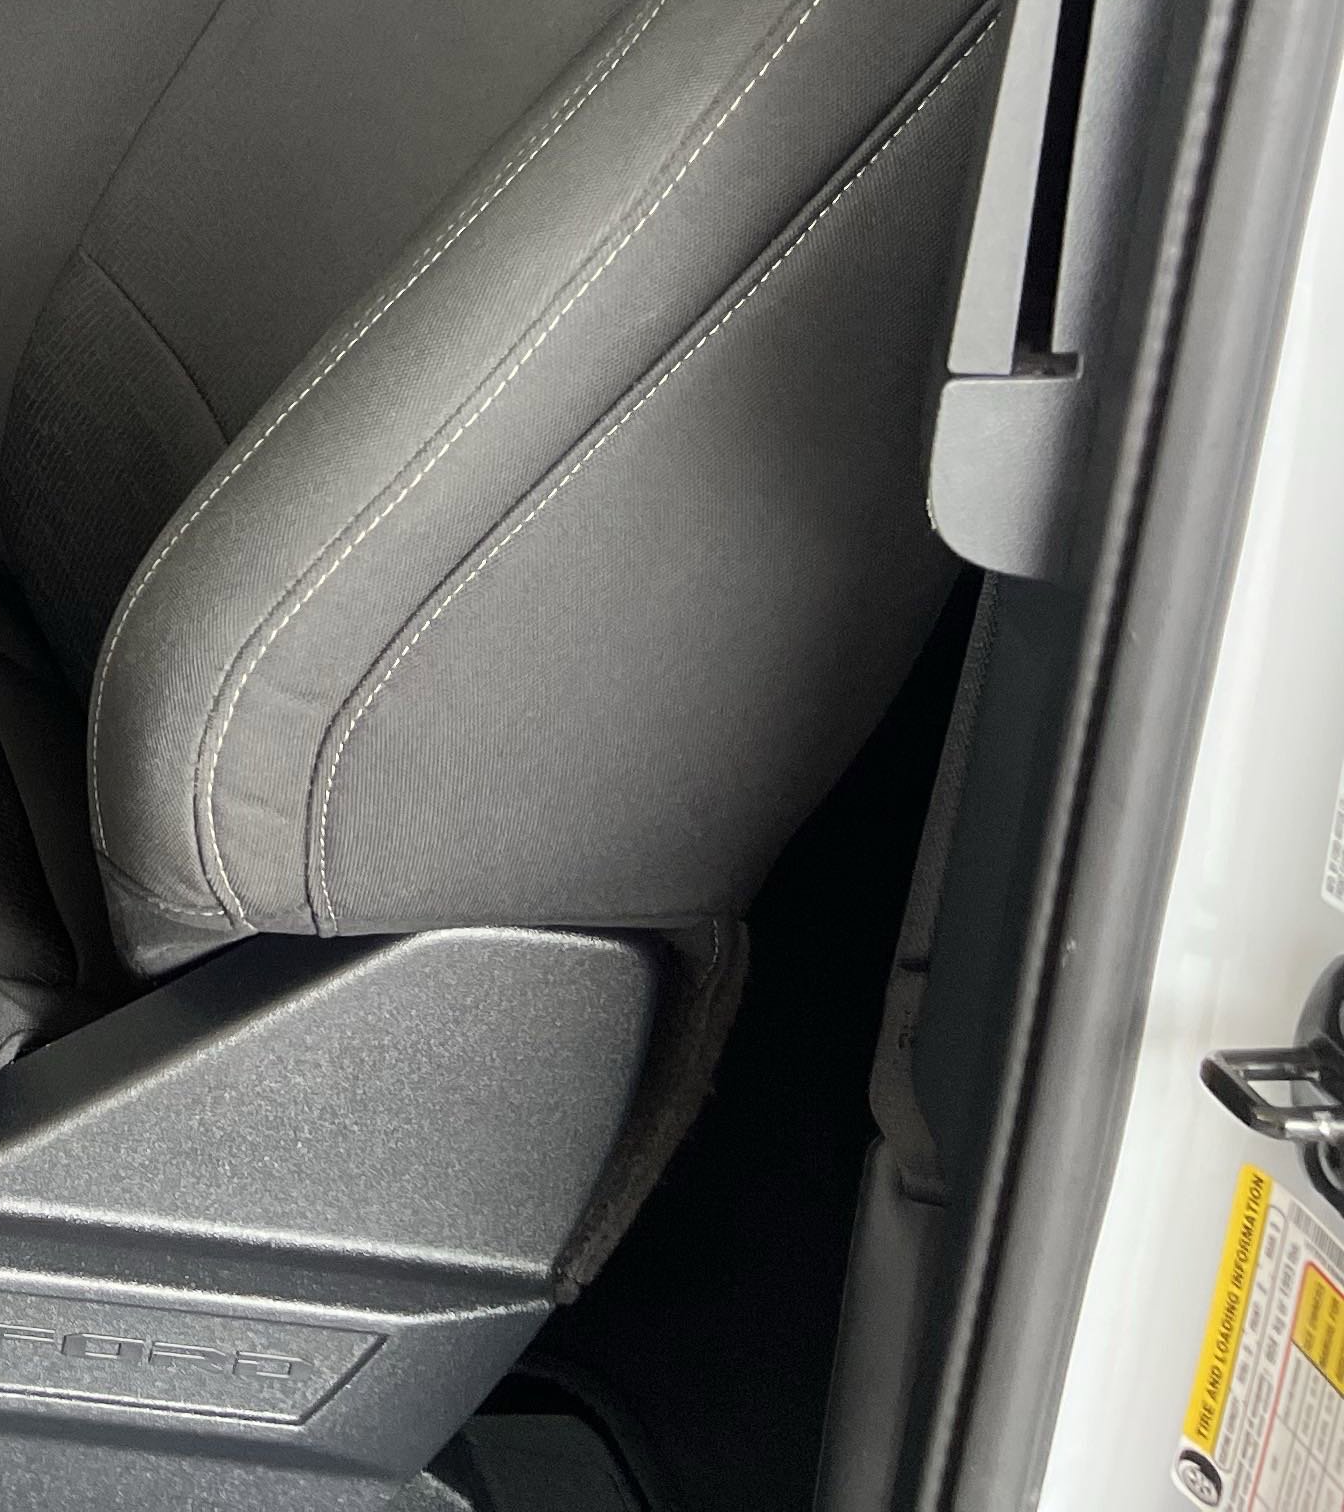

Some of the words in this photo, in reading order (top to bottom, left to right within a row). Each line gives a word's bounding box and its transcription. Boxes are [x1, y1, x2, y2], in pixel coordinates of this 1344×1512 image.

[1230, 1173, 1265, 1291] INFORMATION
[1216, 1291, 1242, 1364] LOADING
[1205, 1363, 1223, 1402] AND
[1196, 1401, 1217, 1440] TIRE
